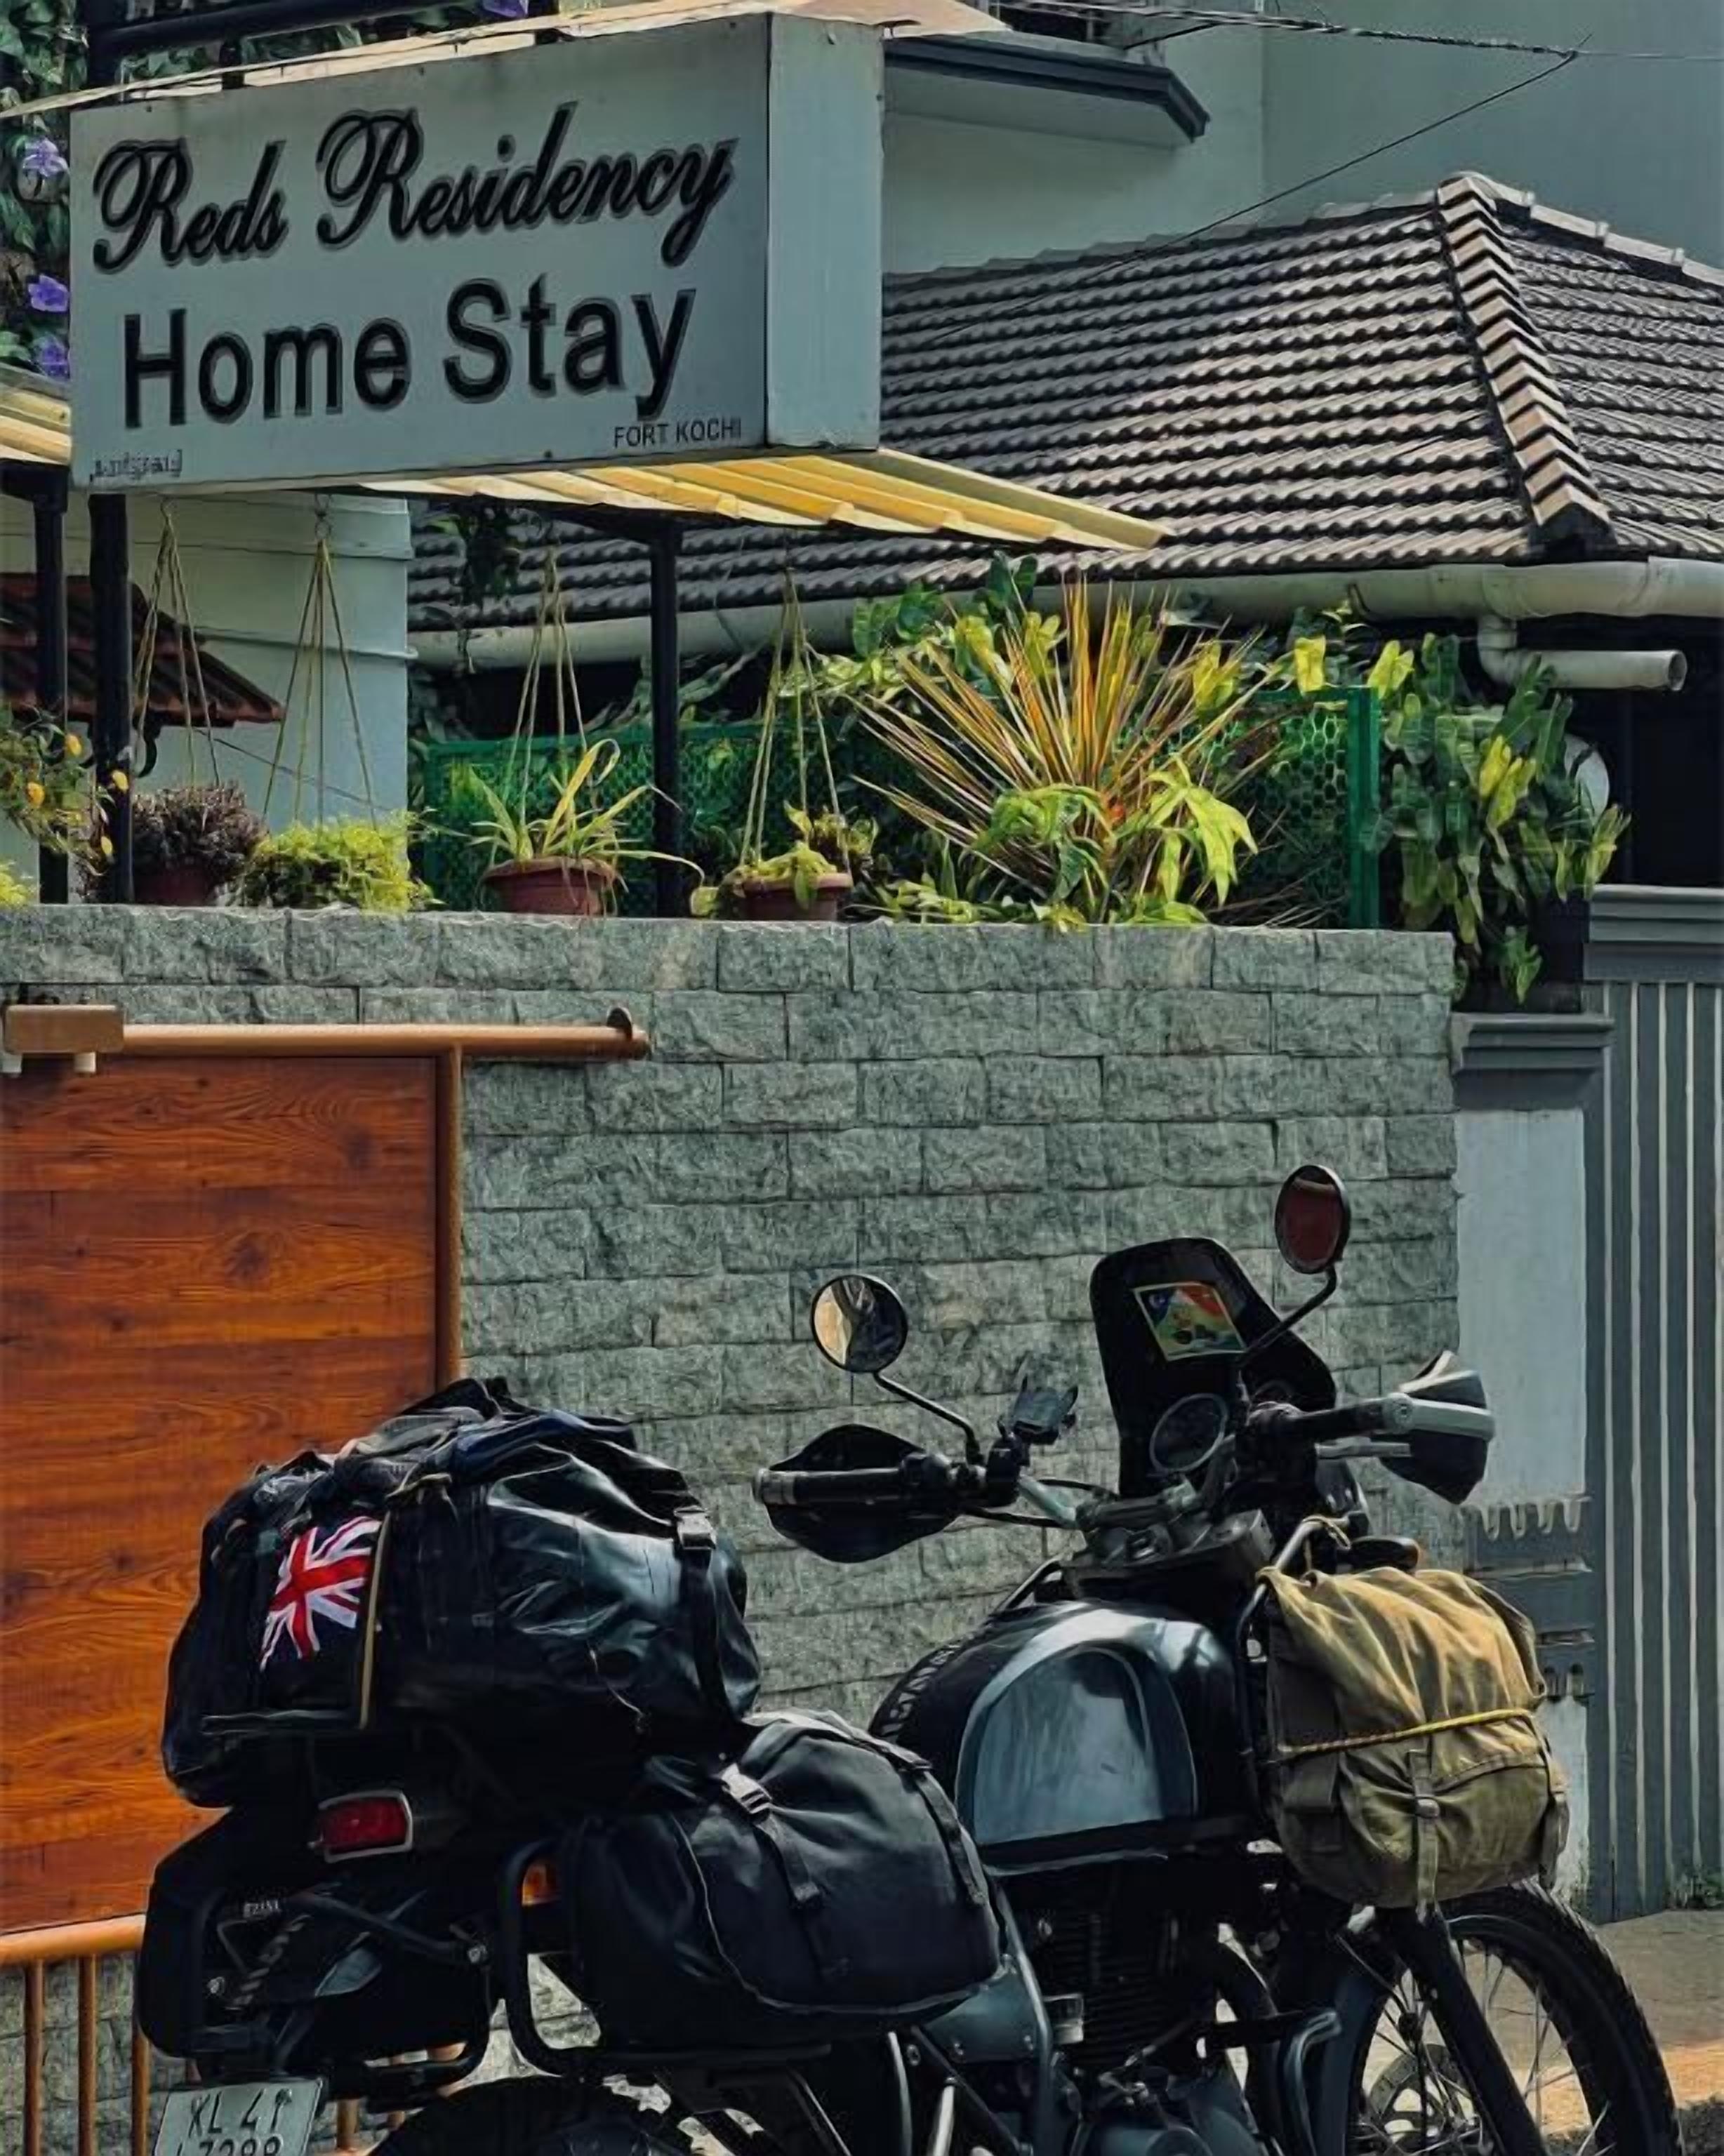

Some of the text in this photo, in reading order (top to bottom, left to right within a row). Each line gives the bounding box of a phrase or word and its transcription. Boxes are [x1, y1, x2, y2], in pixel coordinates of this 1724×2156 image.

[93, 100, 740, 274] Reds Residency
[124, 272, 696, 430] Home Stay
[614, 418, 742, 448] FORT KOCHI
